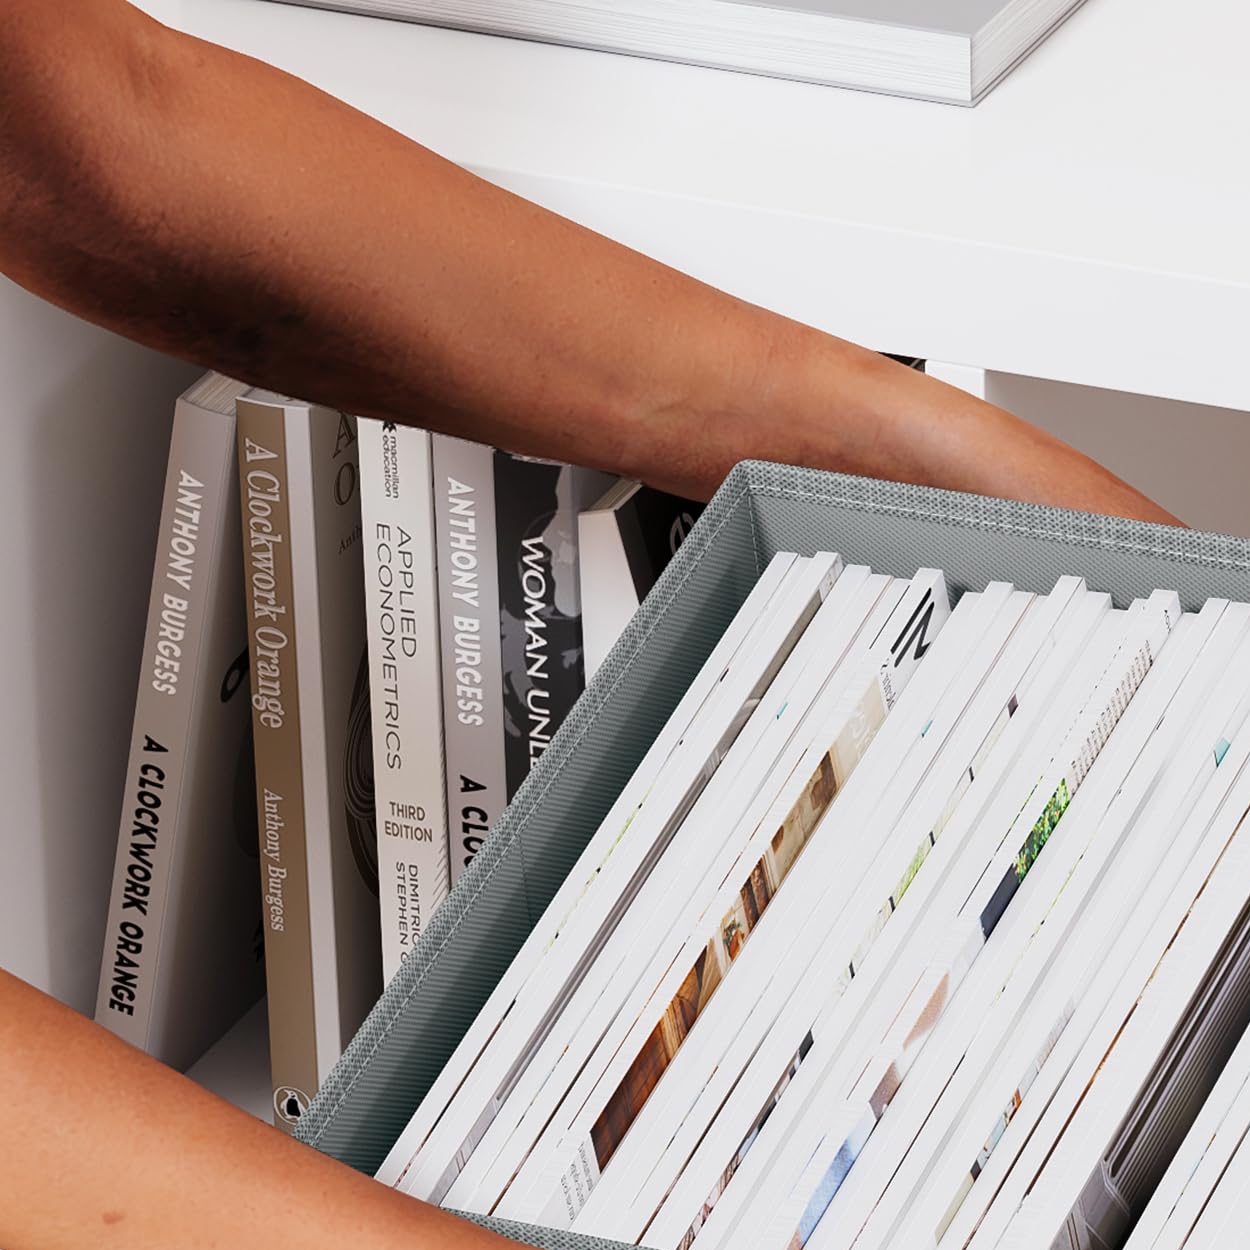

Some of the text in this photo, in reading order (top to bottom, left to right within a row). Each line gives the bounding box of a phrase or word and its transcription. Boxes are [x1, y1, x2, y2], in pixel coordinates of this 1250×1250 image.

[382, 434, 392, 498] education
[389, 435, 400, 498] macmillan
[152, 469, 204, 696] ANTHONY BURGESS
[245, 437, 288, 729] A Clockwork Orange
[376, 523, 402, 770] ECONOMETRICS
[397, 526, 416, 658] APPLIED
[447, 477, 483, 727] ANTHONY BURGESS
[521, 536, 549, 678] WOMAN
[384, 820, 433, 843] EDITION
[389, 801, 426, 821] THIRD
[460, 774, 487, 792] A
[109, 734, 169, 1017] A CLOCKWORK ORANGE
[263, 788, 287, 932] Anthony Burgess
[395, 861, 409, 946] STEPHEN
